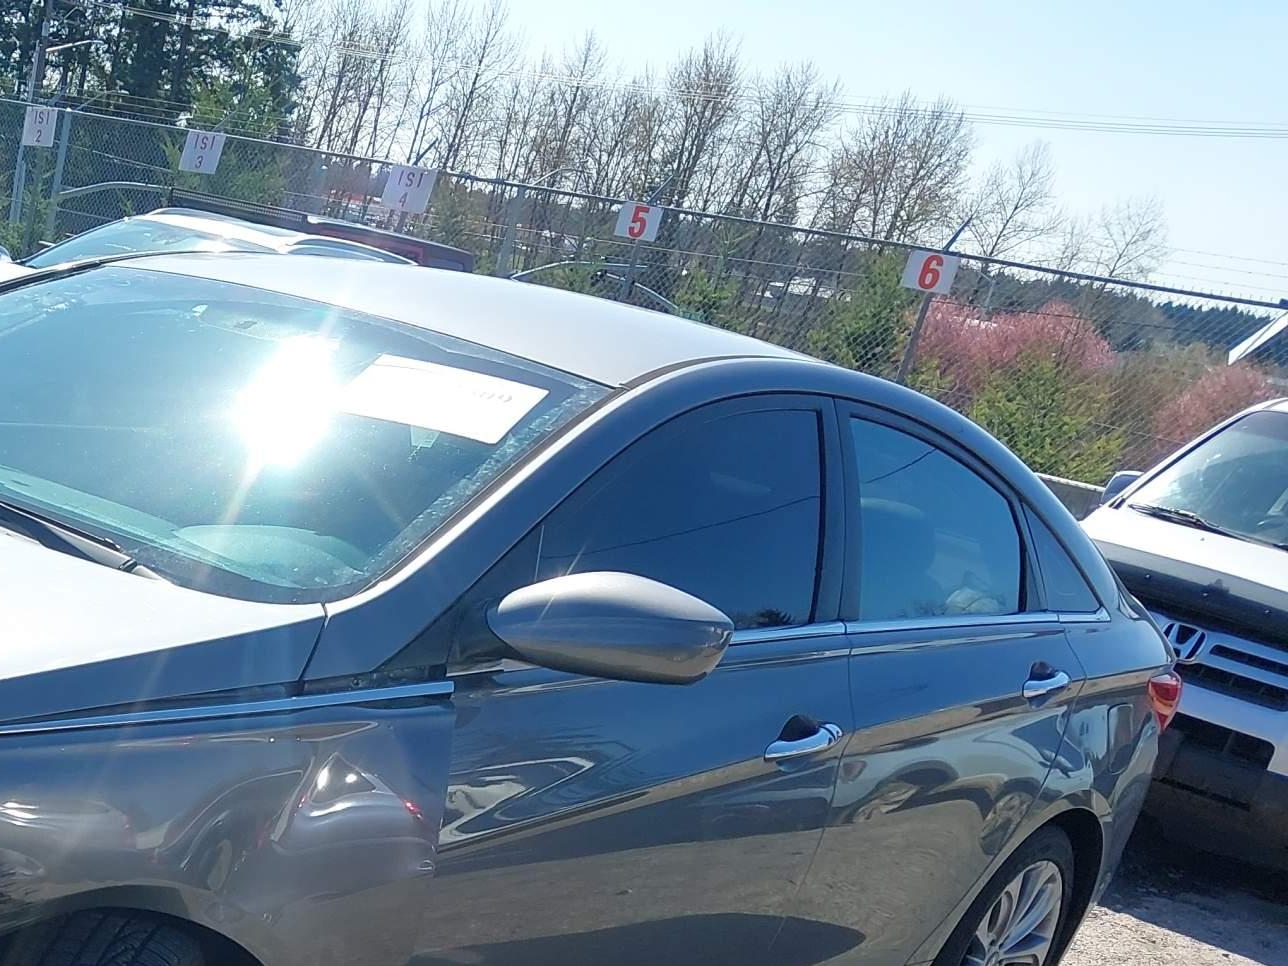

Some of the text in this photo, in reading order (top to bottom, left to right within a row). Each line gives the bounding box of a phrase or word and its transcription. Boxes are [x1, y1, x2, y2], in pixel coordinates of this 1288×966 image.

[34, 129, 43, 143] 2
[194, 155, 204, 169] 3
[398, 191, 408, 208] 4
[628, 205, 650, 238] 5
[918, 254, 944, 290] 6
